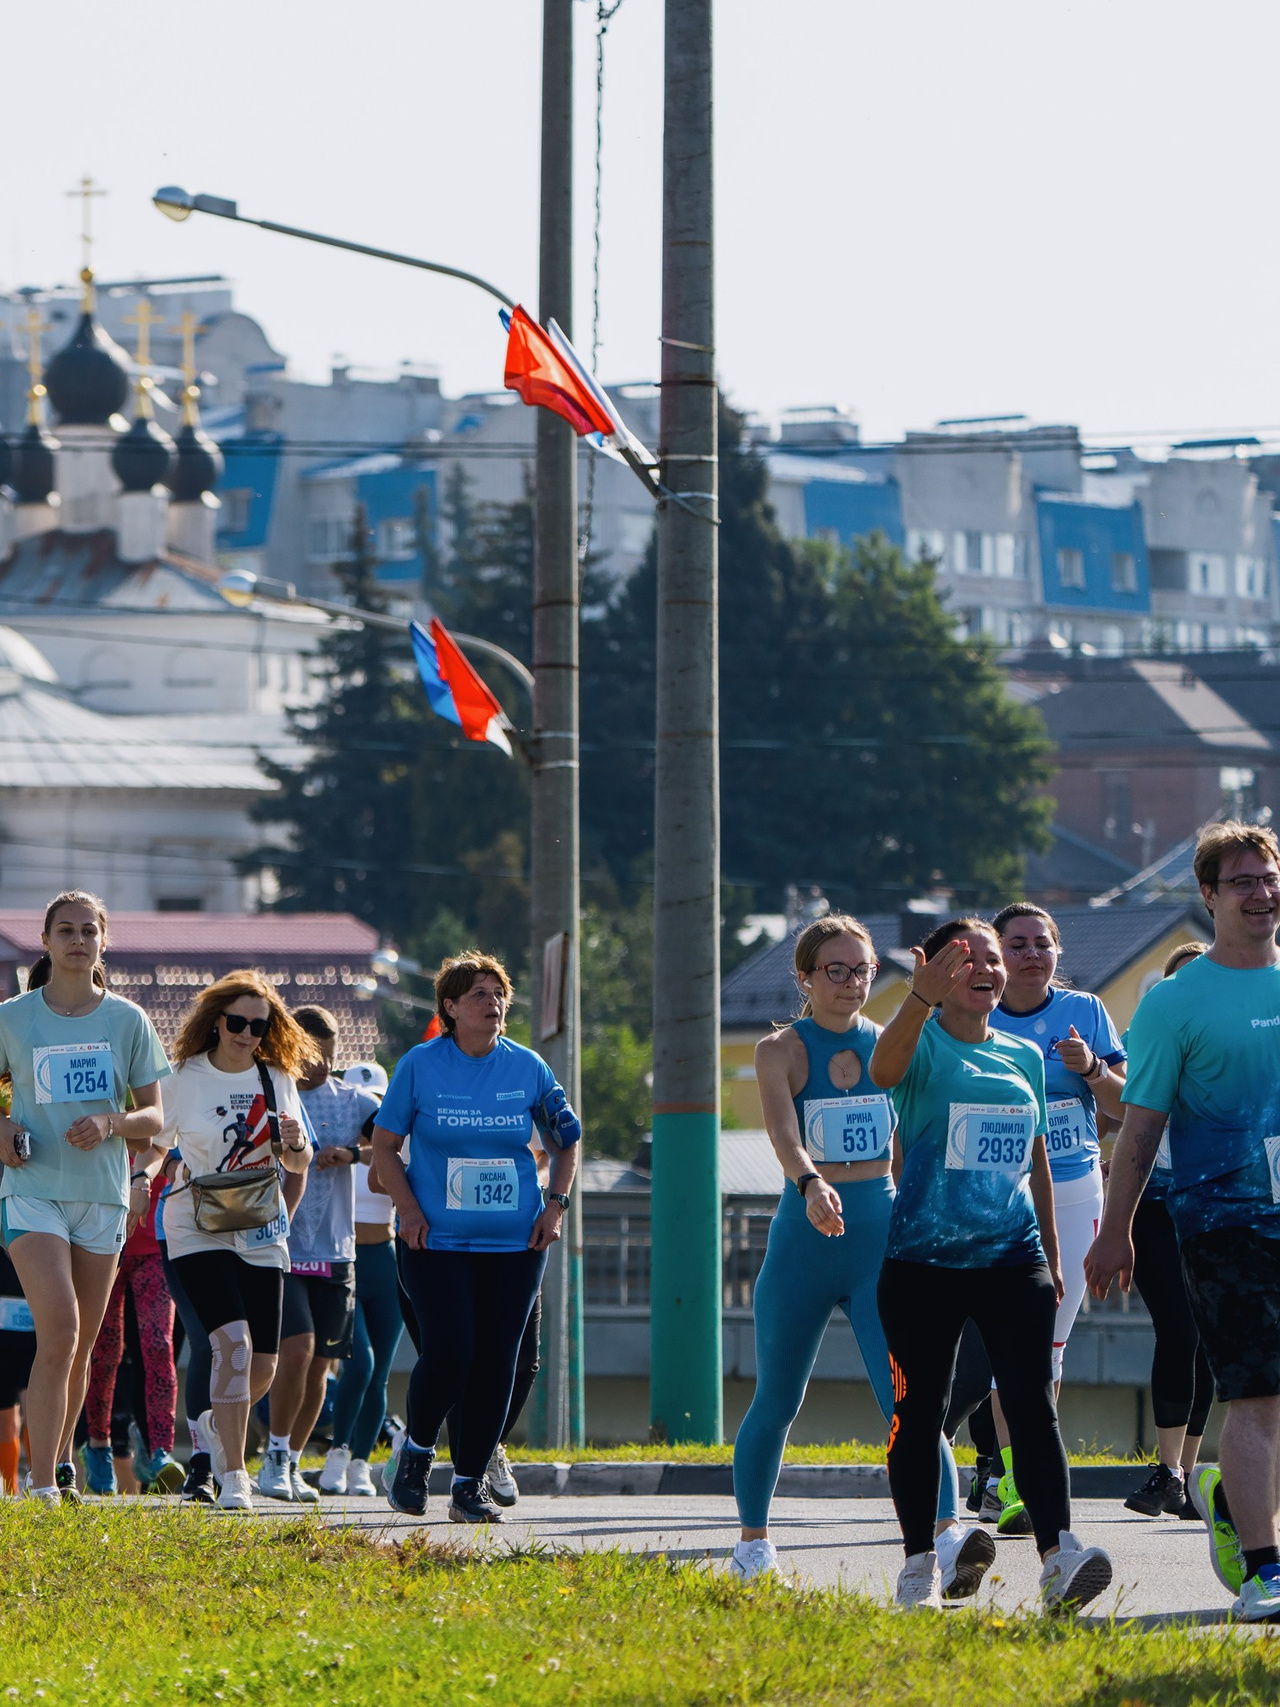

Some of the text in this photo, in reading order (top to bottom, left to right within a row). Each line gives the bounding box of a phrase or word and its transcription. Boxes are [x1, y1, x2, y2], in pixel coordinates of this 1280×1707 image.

[70, 1057, 97, 1069] МАРИЯ
[63, 1070, 108, 1095] 1254
[437, 1108, 468, 1116] БЕЖИМ
[846, 1112, 873, 1125] ИРИНА
[437, 1114, 524, 1127] ГОРИЗОНТ
[980, 1121, 1025, 1135] ЛЮДМИЛА
[843, 1126, 878, 1153] 531
[977, 1137, 1027, 1164] 2933
[480, 1172, 507, 1182] ОКСАНА
[474, 1183, 513, 1205] 1342
